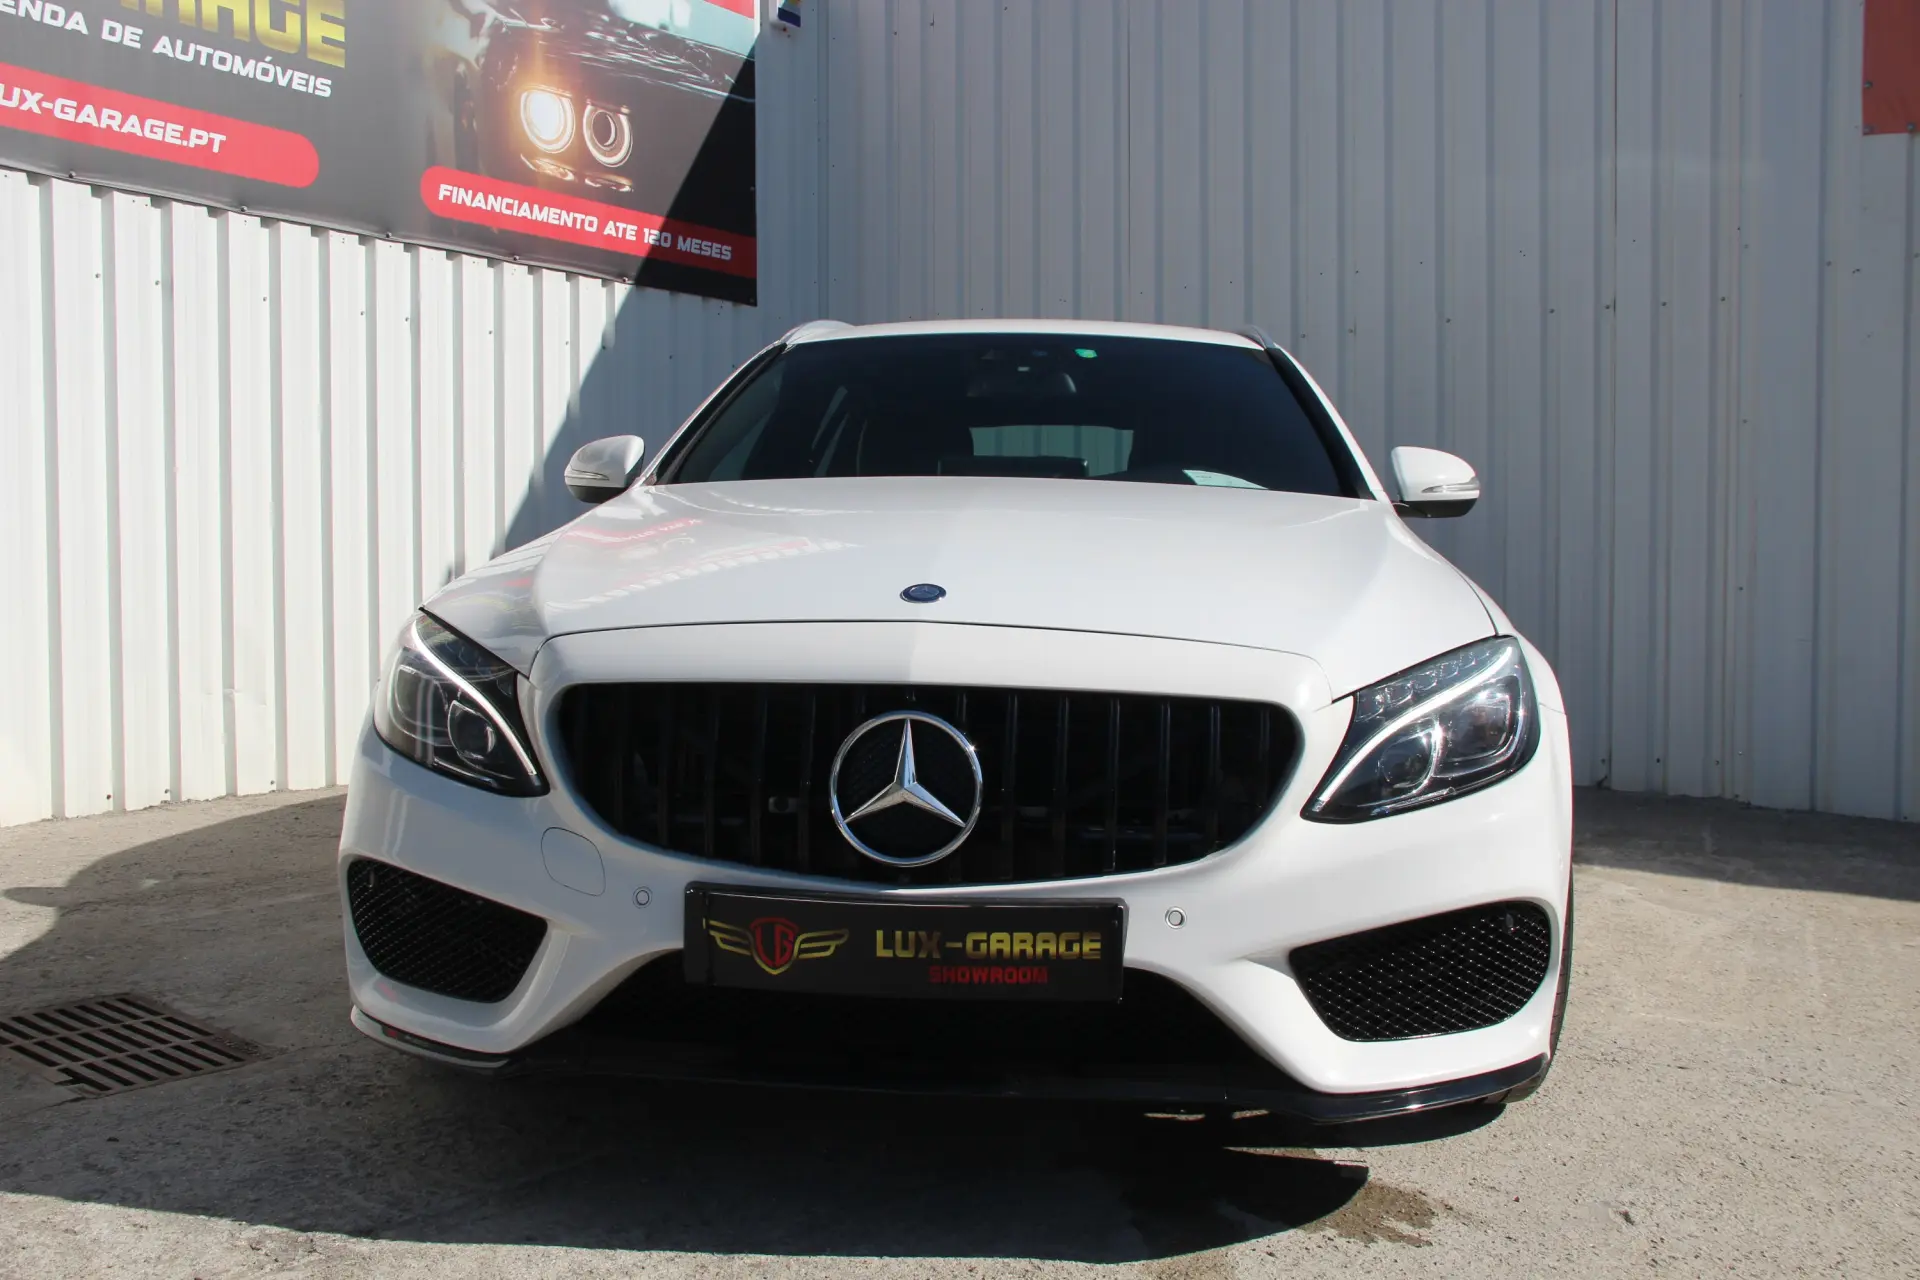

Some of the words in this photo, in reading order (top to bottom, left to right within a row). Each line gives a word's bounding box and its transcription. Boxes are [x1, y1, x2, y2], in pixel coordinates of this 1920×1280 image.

[101, 19, 143, 49] DE
[152, 35, 332, 97] AUTOMÓVEIS
[0, 83, 226, 153] UX-GARAGE.PT
[438, 183, 598, 232] FINANCIAMENTO
[603, 220, 637, 241] ATE
[643, 227, 672, 248] 120
[677, 235, 732, 260] MESES
[876, 929, 1101, 960] LUX-GARAGE
[928, 965, 1049, 985] SHOWROOM
